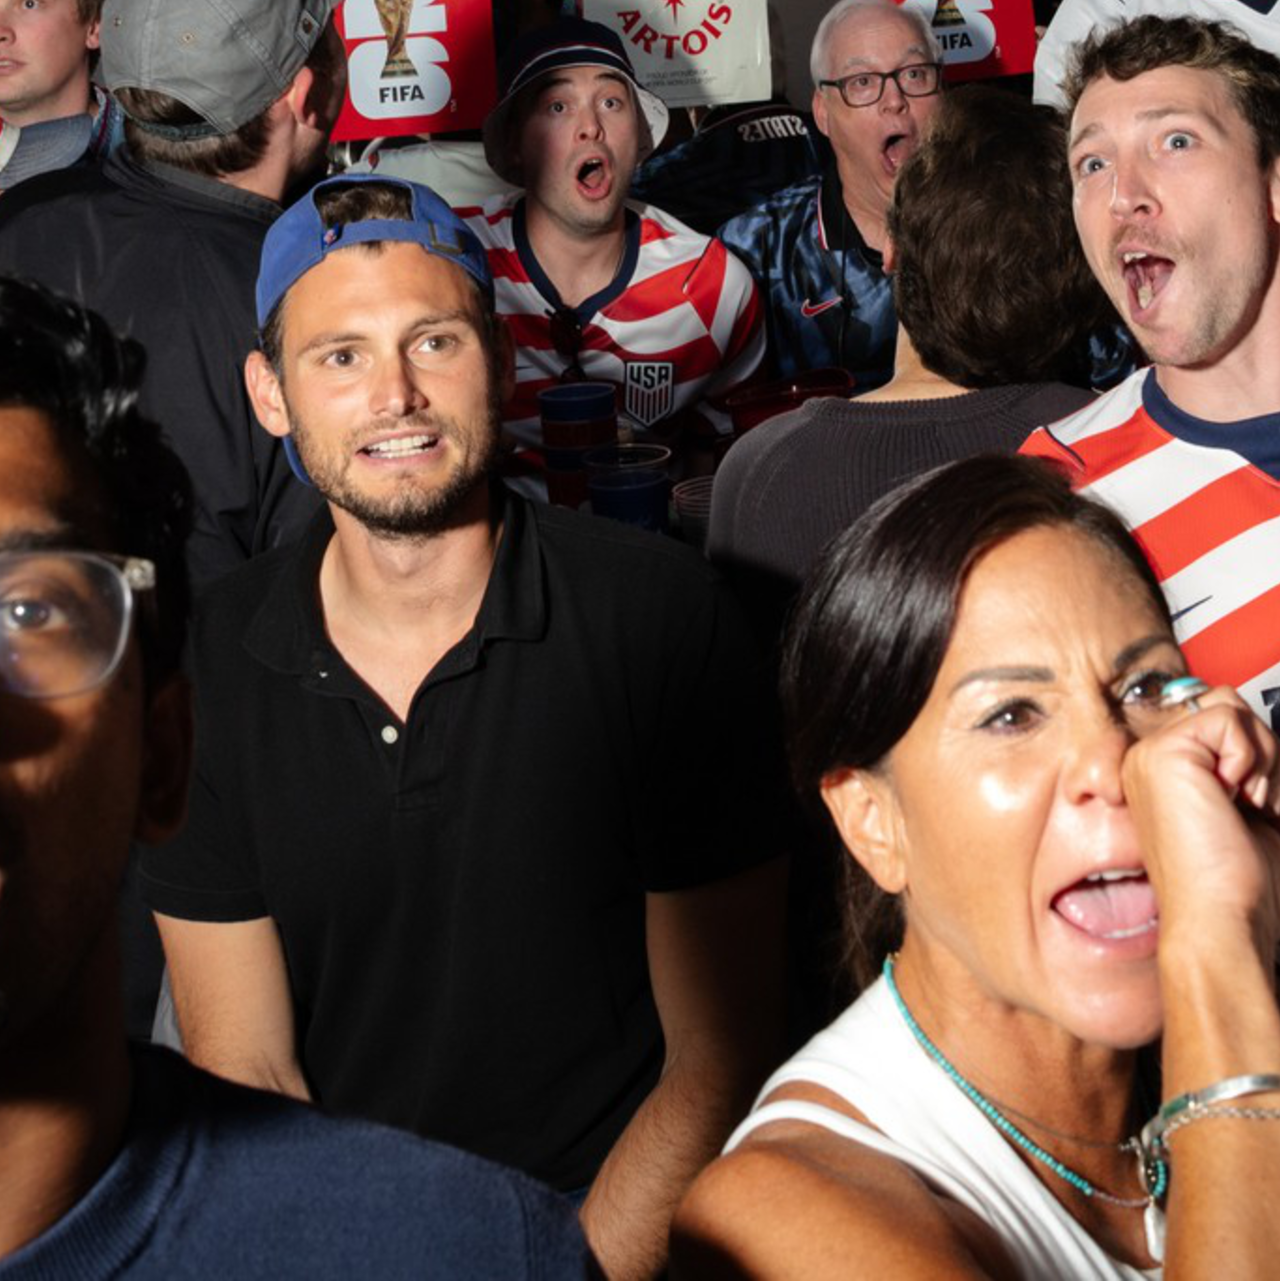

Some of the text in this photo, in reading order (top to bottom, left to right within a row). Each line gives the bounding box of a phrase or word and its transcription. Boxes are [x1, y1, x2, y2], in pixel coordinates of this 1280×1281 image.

[616, 2, 732, 59] ARTOIS
[378, 86, 425, 104] FIFA
[629, 365, 672, 388] USA
